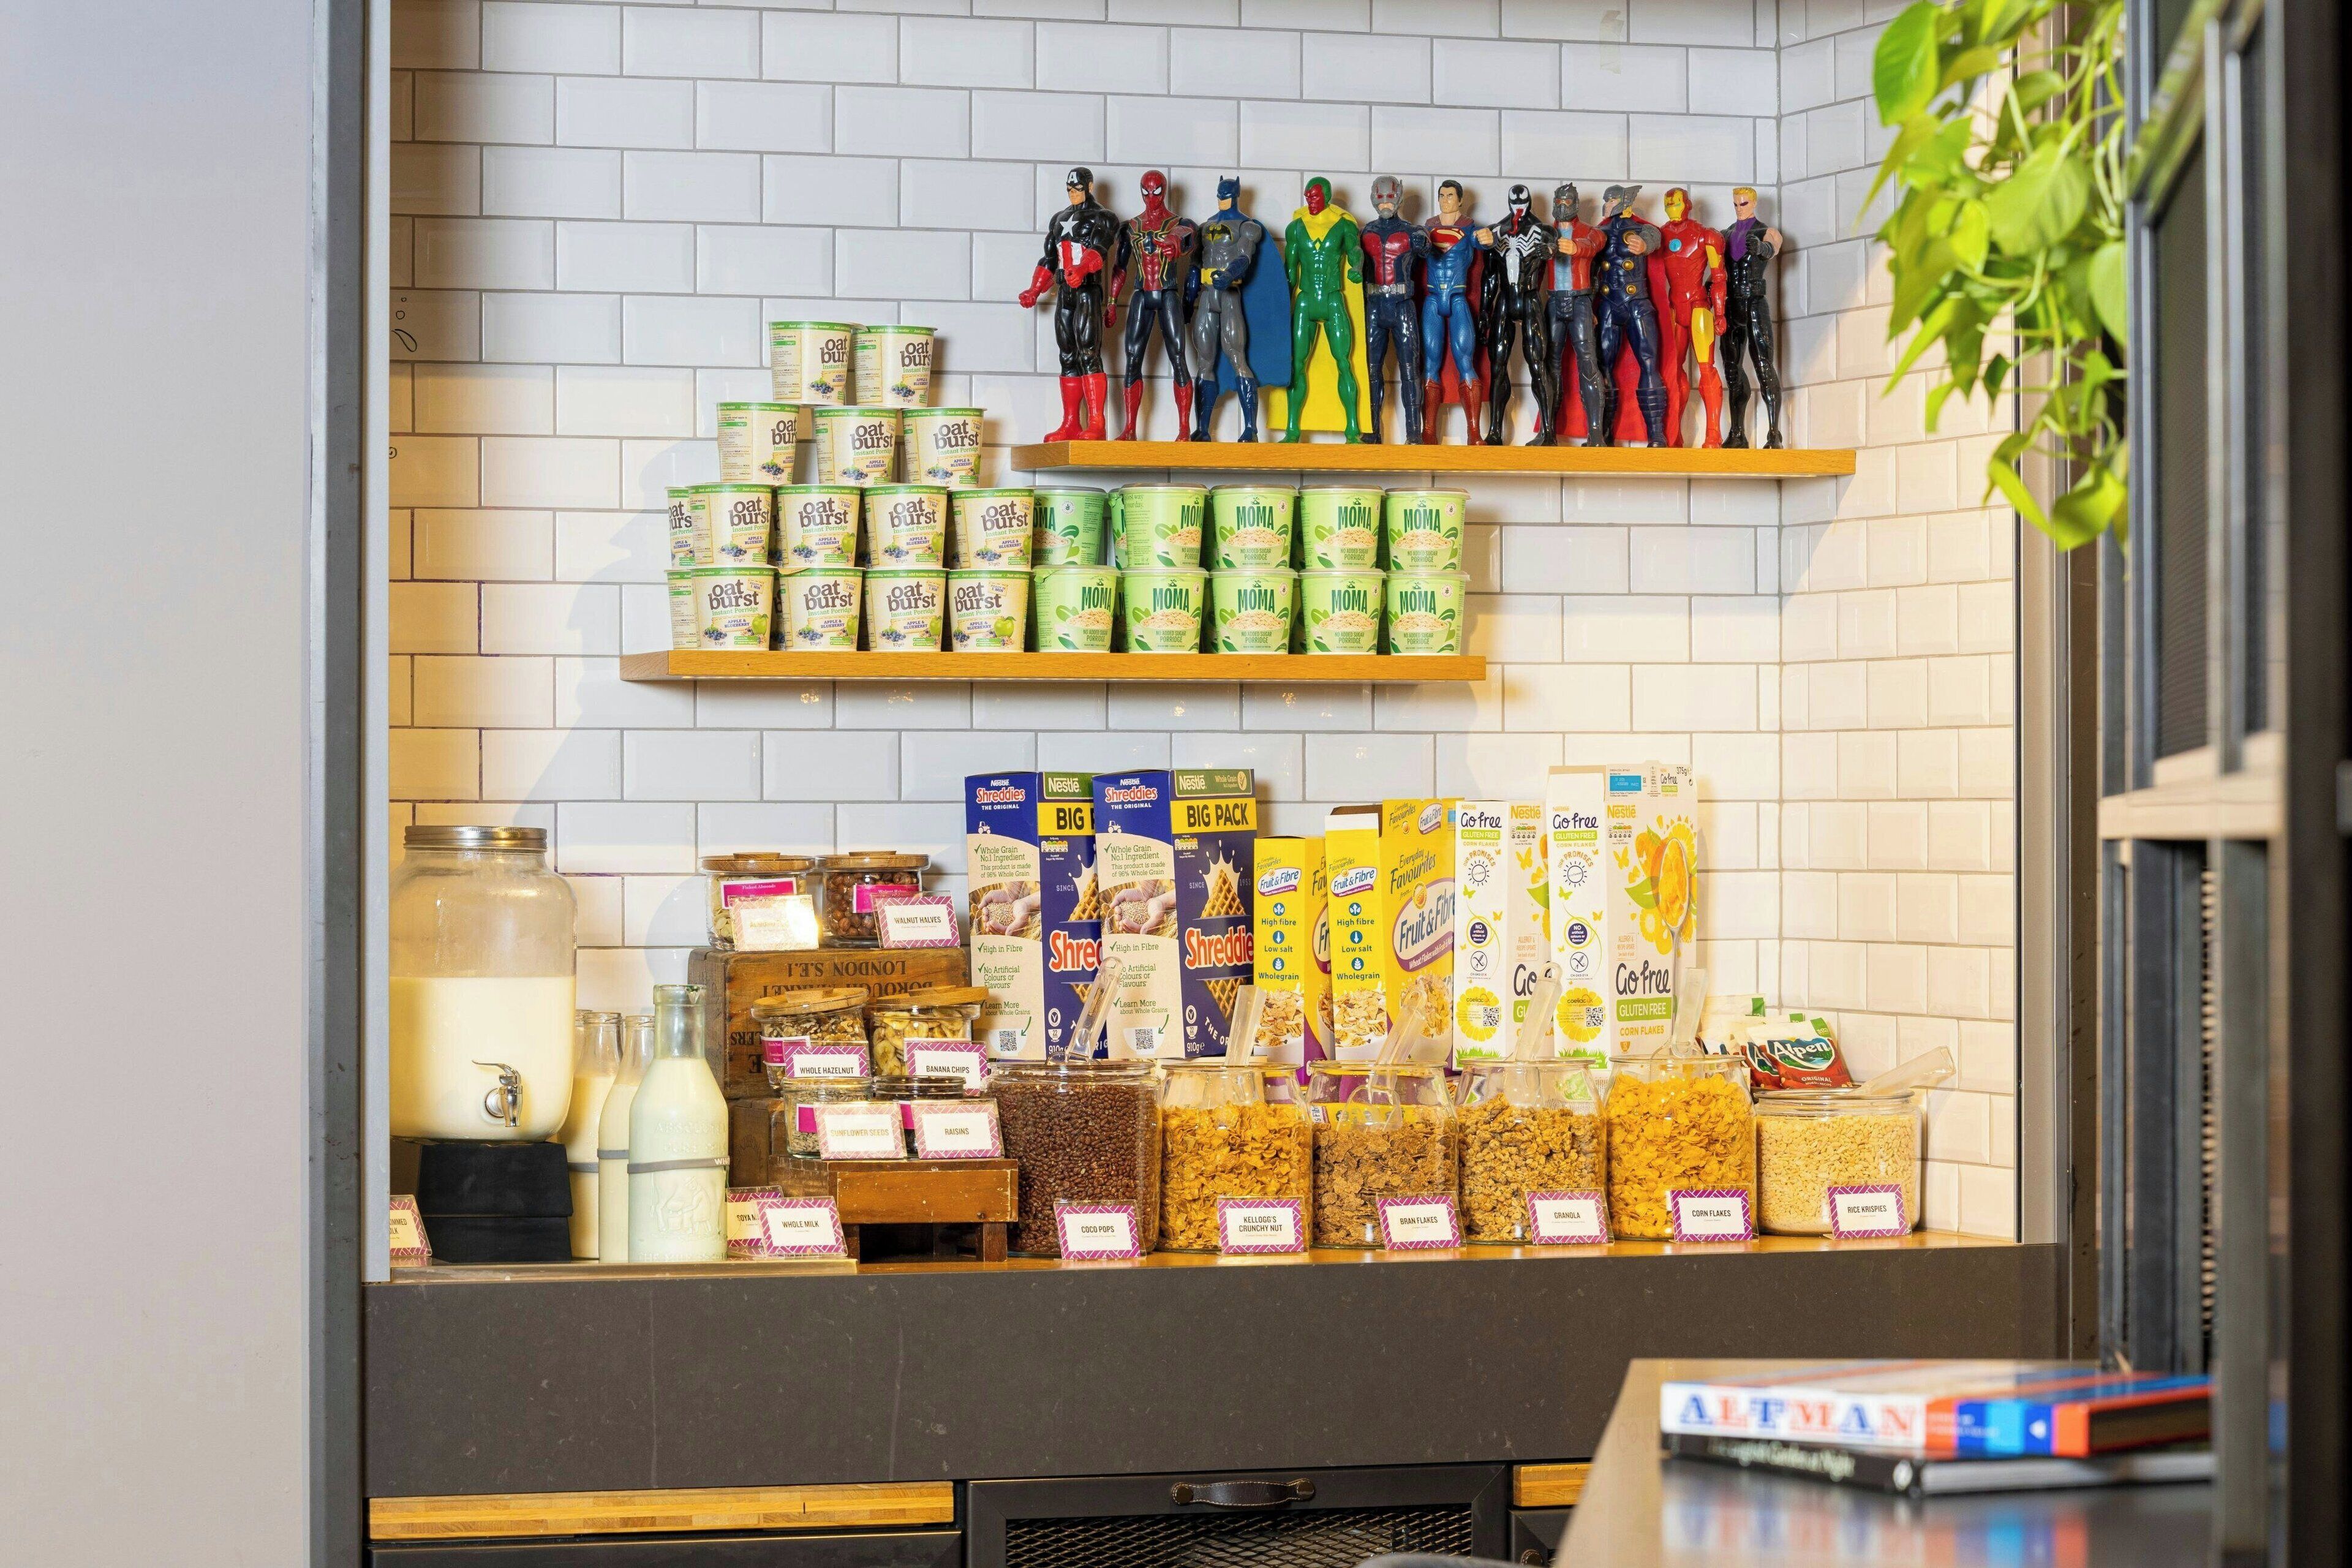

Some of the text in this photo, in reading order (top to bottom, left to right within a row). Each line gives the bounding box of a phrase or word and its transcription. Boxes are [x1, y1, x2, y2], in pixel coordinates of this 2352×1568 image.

[856, 421, 884, 437] oat
[938, 420, 969, 437] oat
[850, 433, 893, 450] burst
[933, 432, 979, 450] burst
[733, 496, 762, 514] oat
[803, 497, 835, 514] oat
[894, 497, 925, 514] oat
[986, 500, 1017, 518] oat
[728, 509, 770, 527] burst
[799, 510, 848, 528] burst
[889, 510, 937, 528] burst
[981, 513, 1028, 531] burst
[1236, 506, 1274, 530] MOMA
[1338, 506, 1371, 530] MOMA
[1404, 508, 1441, 533] MOMA
[712, 579, 744, 597] oat
[809, 579, 840, 597] oat
[891, 581, 922, 598] oat
[957, 582, 985, 598] oat
[708, 591, 759, 611] burst
[804, 592, 853, 611] burst
[886, 593, 936, 612] burst
[955, 594, 1002, 612] burst
[1081, 586, 1112, 611] MOMA
[1153, 588, 1189, 612] MOMA
[1237, 589, 1275, 613] MOMA
[1331, 589, 1367, 614] MOMA
[1400, 591, 1436, 614] MOMA
[976, 786, 1025, 803] Shreddies
[1105, 785, 1158, 803] Shreddies
[1056, 807, 1084, 831] BIG
[1187, 803, 1249, 827] BIG PACK
[1461, 812, 1502, 827] Go free
[1553, 813, 1599, 829] Go free
[993, 853, 1025, 863] Ingredient
[1126, 853, 1159, 861] Ingredient
[1400, 847, 1425, 869] Everyday
[1261, 870, 1299, 890] Fruit & Fibre
[1334, 877, 1348, 891] Fruit
[1349, 876, 1354, 885] &
[1355, 870, 1374, 884] Fibre
[1390, 852, 1436, 895] Favourites
[1262, 919, 1278, 927] High
[1400, 911, 1426, 952] Fruit
[1427, 909, 1435, 936] &
[984, 945, 997, 954] High
[833, 960, 907, 976] LONDON
[1337, 972, 1380, 981] Wholegrain
[1616, 960, 1671, 995] Go free
[1619, 1003, 1666, 1017] GLUTEN FREE
[1205, 1017, 1217, 1038] THE
[1620, 1025, 1664, 1036] CORN FLAKES
[1773, 1041, 1830, 1060] Alpen
[1679, 1395, 1917, 1438] ALTMAN
